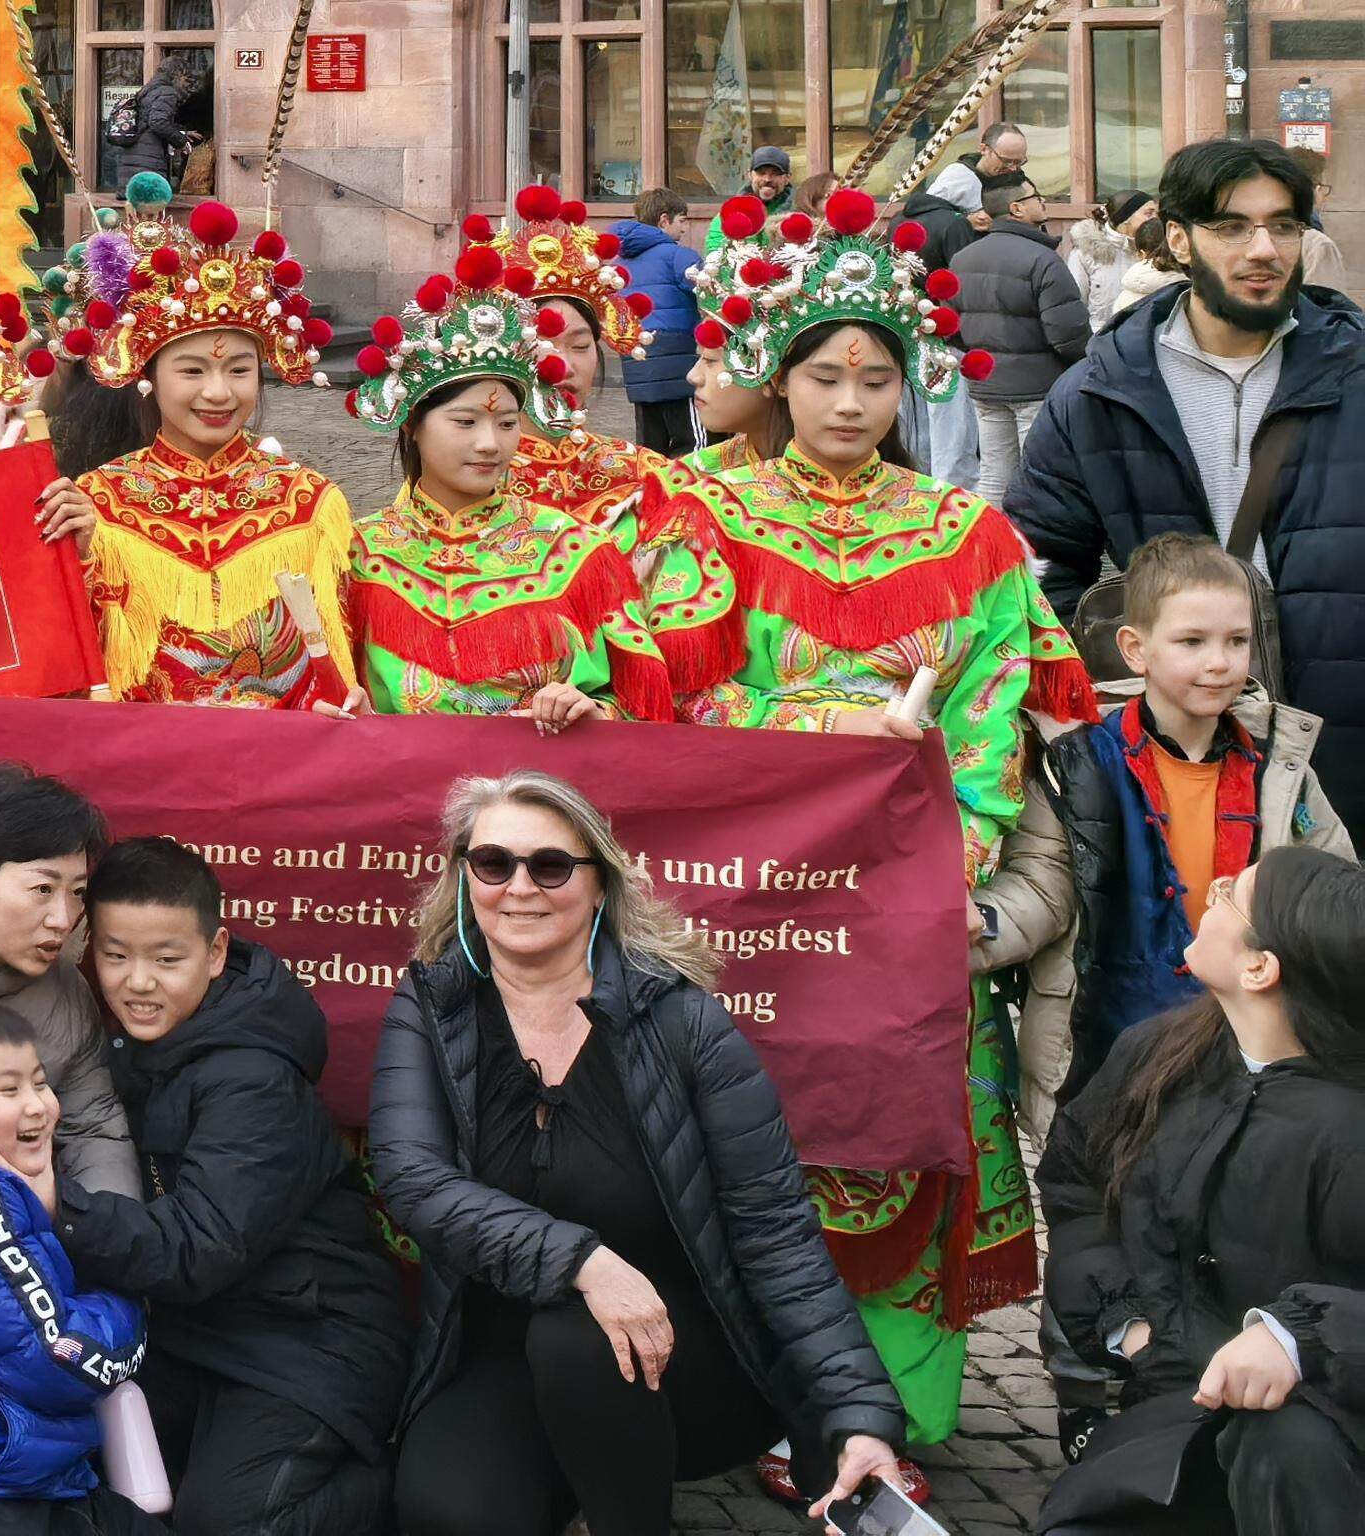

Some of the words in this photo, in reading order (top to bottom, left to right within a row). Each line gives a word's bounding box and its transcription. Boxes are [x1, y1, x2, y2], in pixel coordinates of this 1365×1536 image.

[240, 51, 259, 66] 23
[272, 841, 347, 871] and
[357, 844, 449, 879] Enjo
[662, 856, 745, 889] und
[757, 859, 862, 892] feiert
